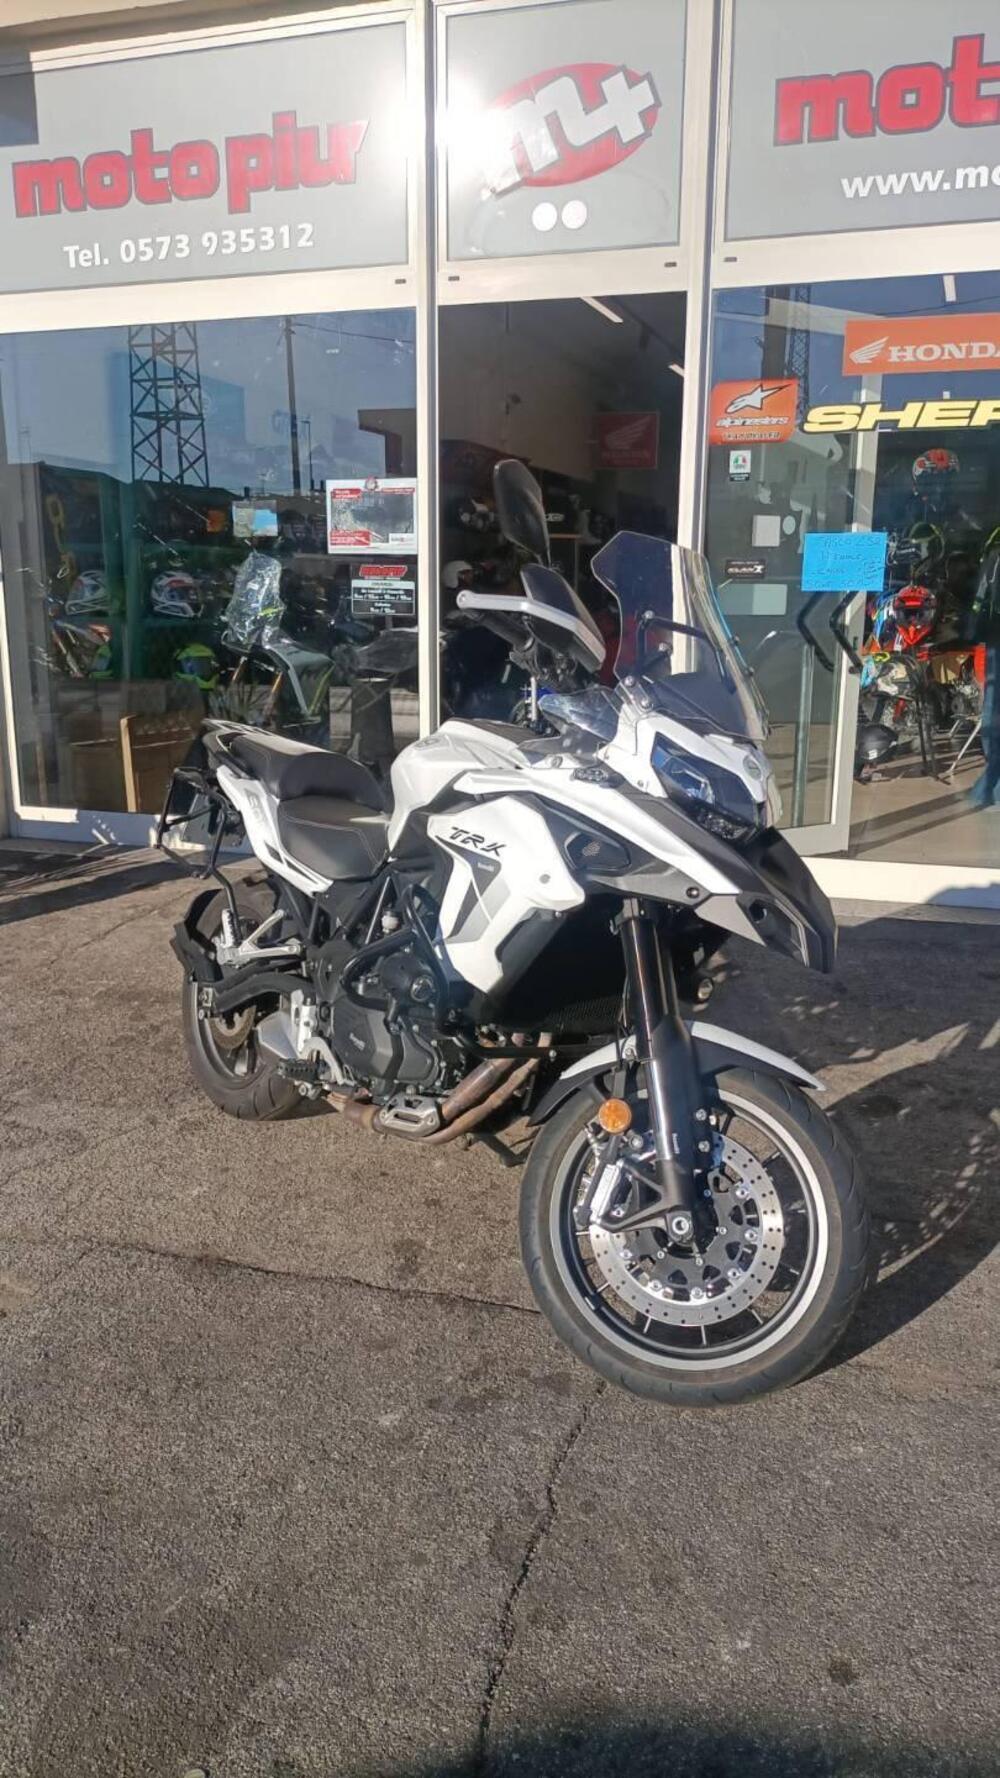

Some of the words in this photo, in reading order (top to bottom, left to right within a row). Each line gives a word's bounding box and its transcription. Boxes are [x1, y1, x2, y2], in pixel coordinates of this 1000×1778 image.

[12, 128, 220, 218] moto
[63, 243, 109, 268] Tel.
[120, 234, 190, 264] 0573
[201, 222, 314, 255] 935312
[888, 341, 1000, 363] HOND
[449, 826, 507, 857] TRK
